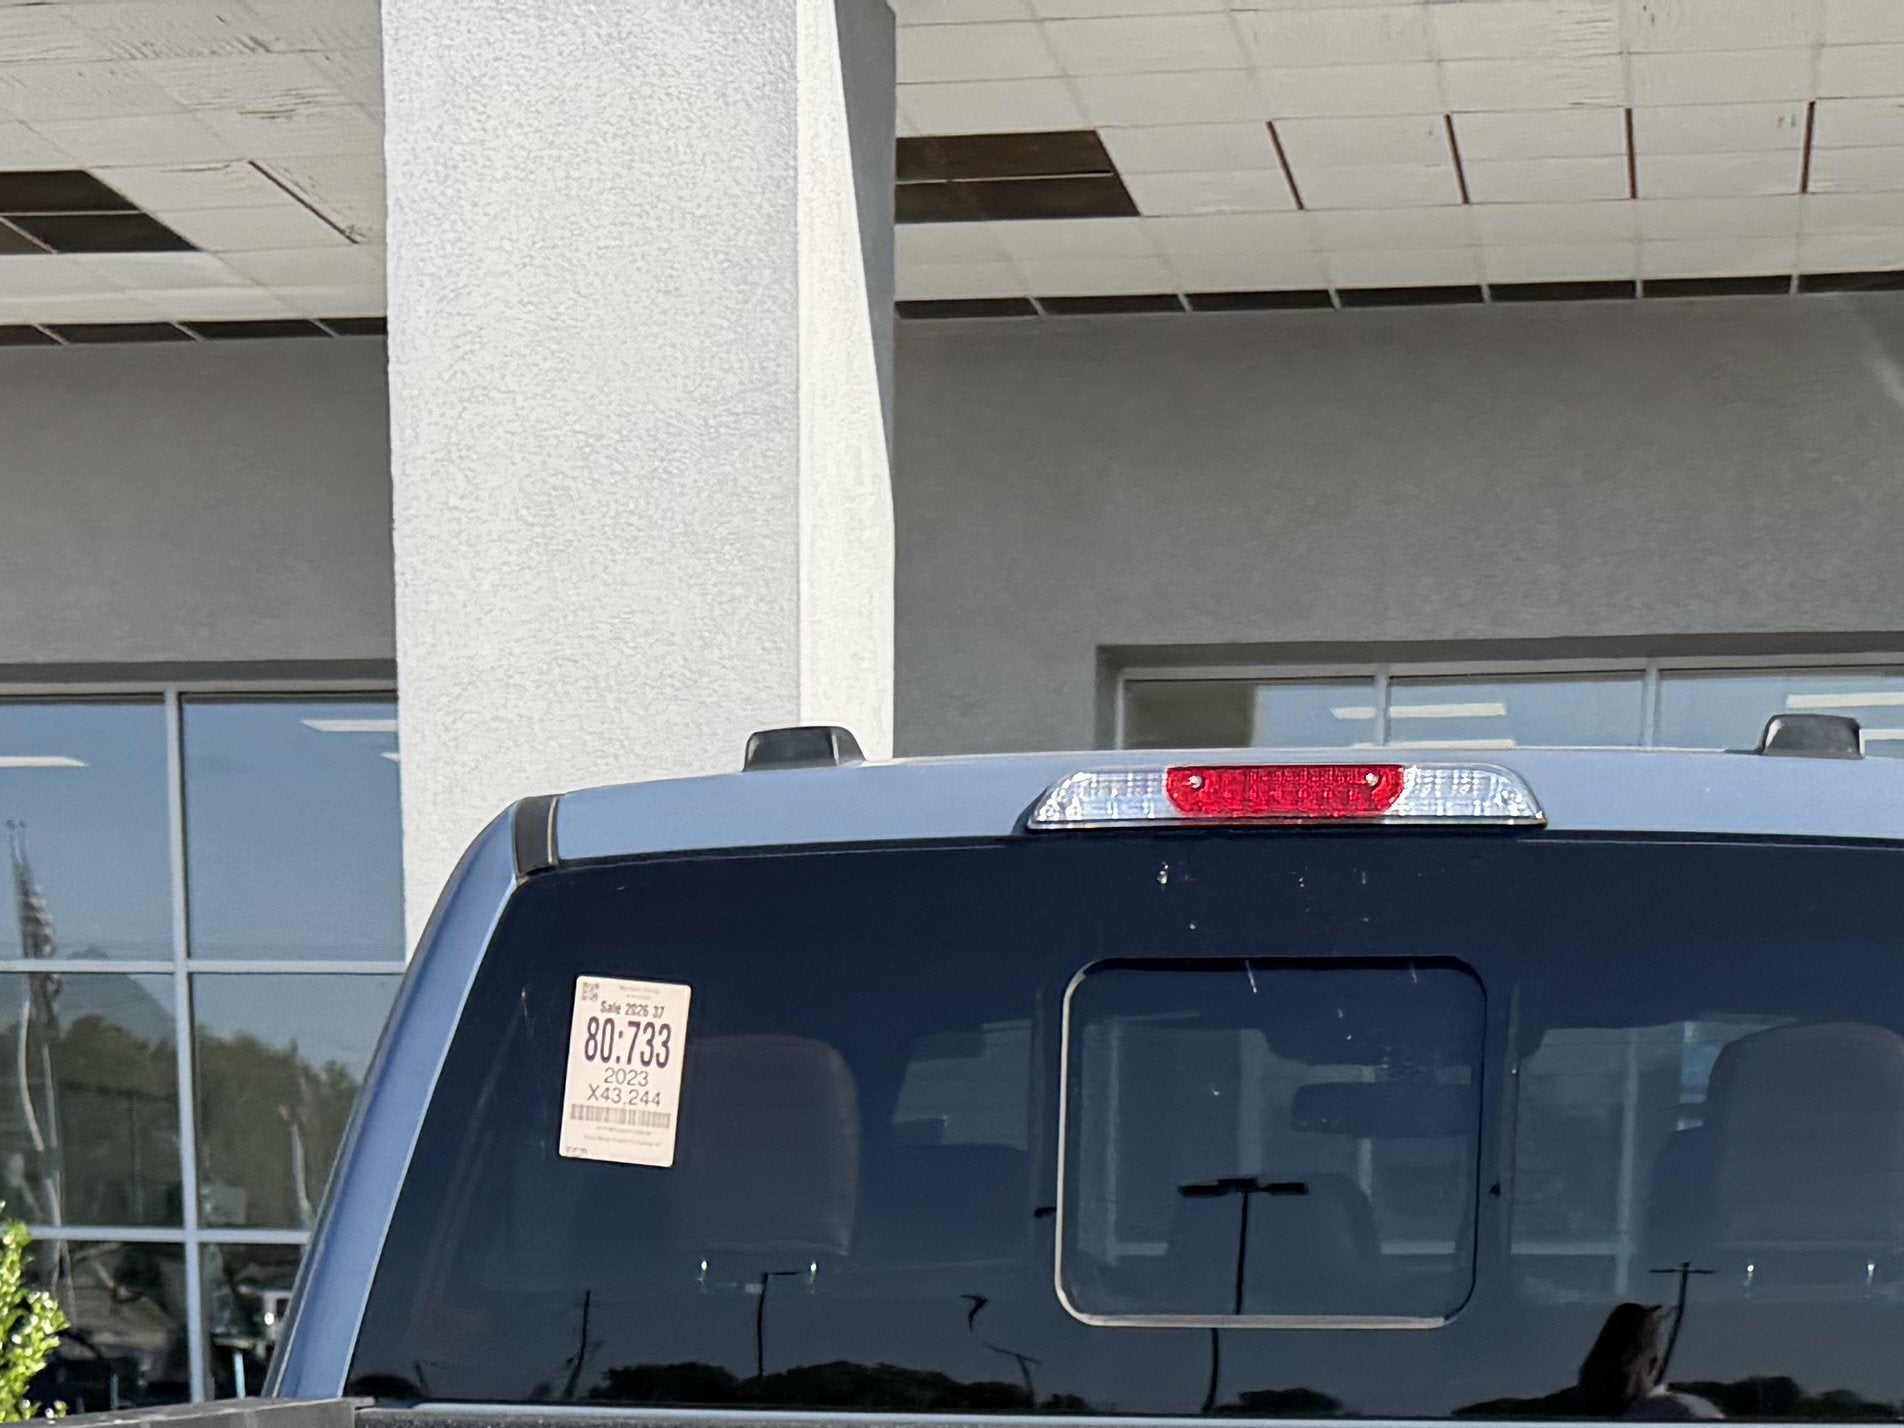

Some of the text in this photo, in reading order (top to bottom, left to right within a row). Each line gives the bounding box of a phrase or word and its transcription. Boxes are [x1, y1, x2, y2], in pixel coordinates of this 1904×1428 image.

[600, 1000, 665, 1019] Sale 2026 37
[584, 1016, 672, 1070] 80:733
[604, 1067, 650, 1088] 2023
